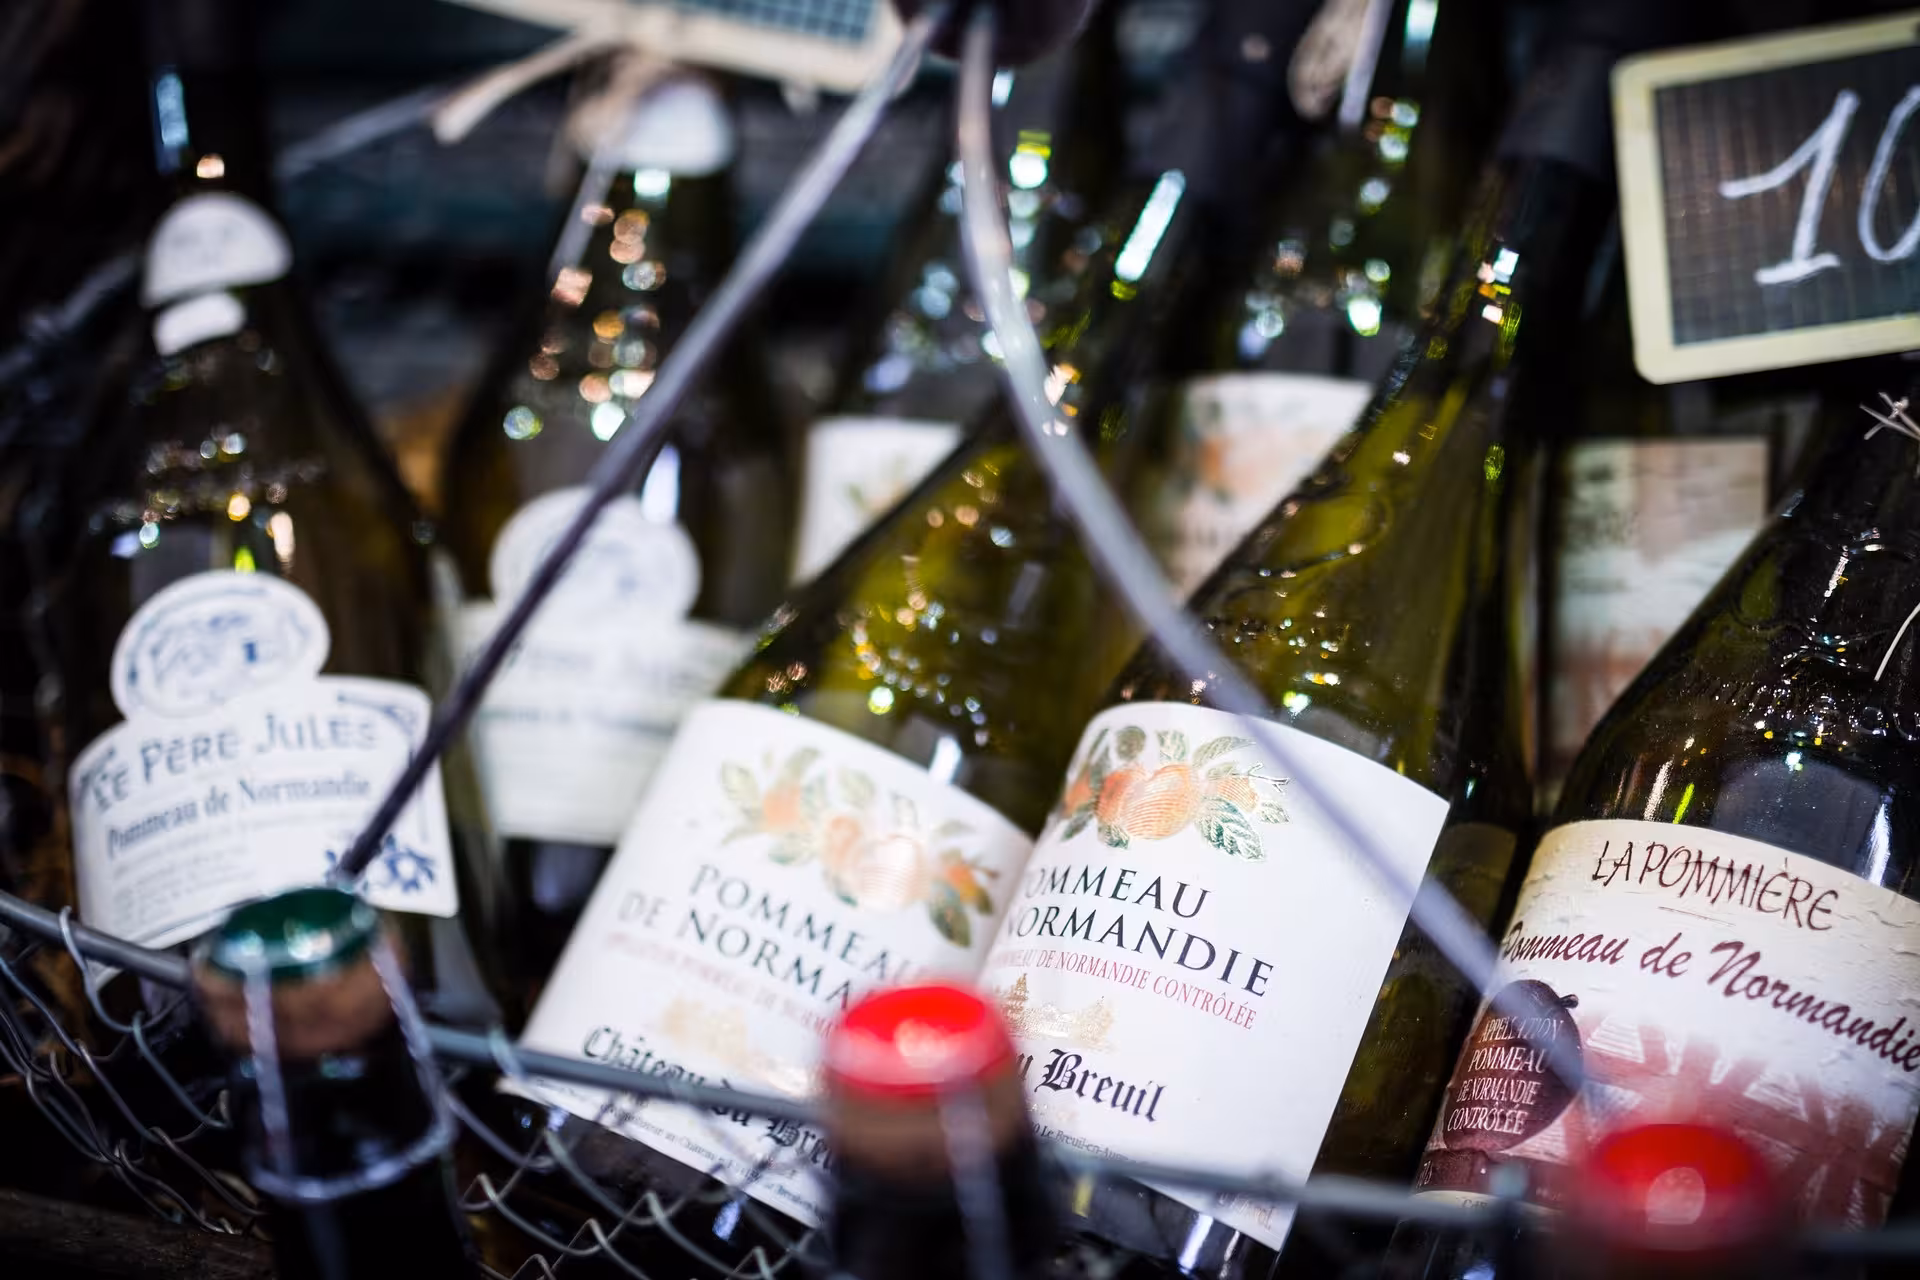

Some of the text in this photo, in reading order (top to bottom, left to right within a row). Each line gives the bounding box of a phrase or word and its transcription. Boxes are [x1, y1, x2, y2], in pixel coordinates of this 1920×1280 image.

[256, 712, 377, 754] JULES
[205, 785, 230, 814] de
[239, 769, 371, 805] Normandie
[1022, 864, 1212, 919] OMMEAU
[1591, 840, 1840, 931] LA POMMIÈRE
[616, 889, 672, 929] DE
[1036, 950, 1057, 969] DE
[1055, 951, 1152, 991] NORMANDIE
[1153, 974, 1258, 1031] CONTRÔLÉE
[1501, 920, 1920, 1073] Pommeau de Normandie
[1467, 1045, 1548, 1074] POMMEAU
[1034, 1048, 1168, 1123] Breuil
[1469, 1077, 1542, 1106] NORMANDIE
[1447, 1101, 1530, 1136] CONTRÔLÉE
